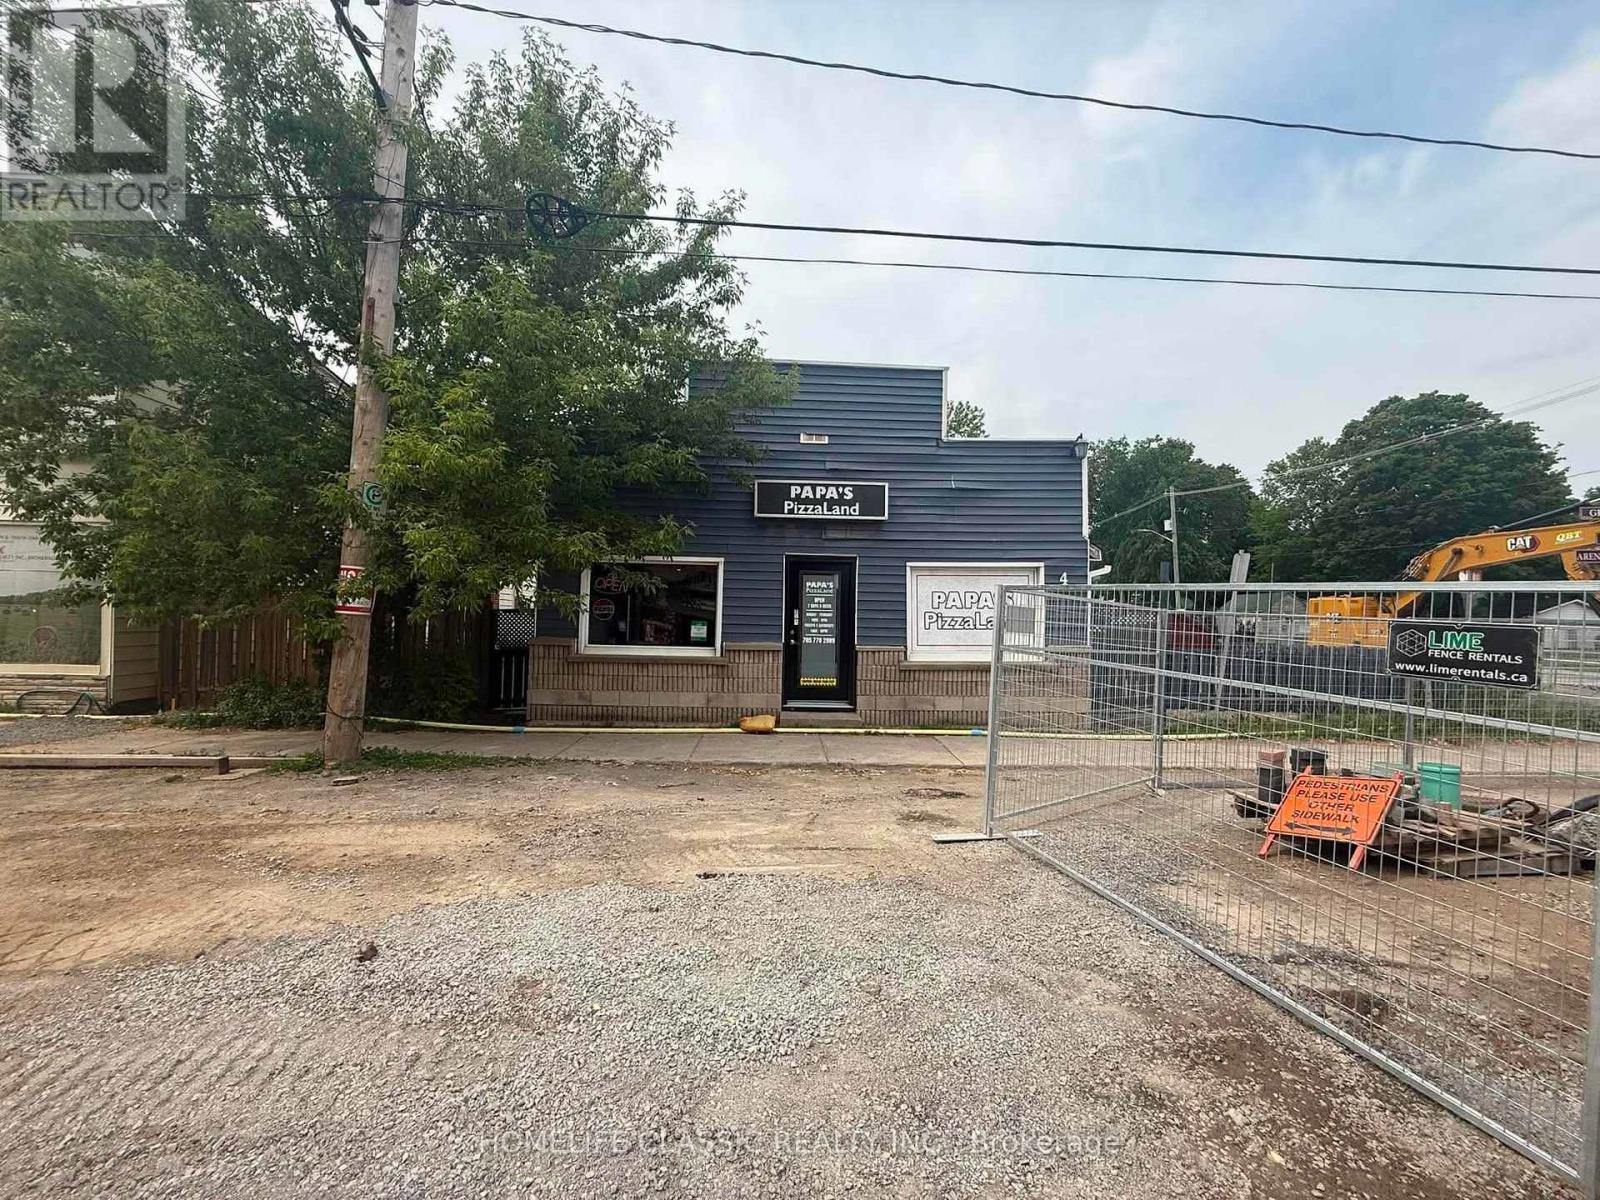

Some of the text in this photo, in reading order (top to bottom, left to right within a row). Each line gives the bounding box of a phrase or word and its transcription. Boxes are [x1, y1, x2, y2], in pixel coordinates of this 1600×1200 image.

[790, 485, 854, 500] PAPA'S
[784, 501, 860, 515] PizzaLand
[1506, 536, 1533, 552] CAT
[806, 581, 834, 589] PAPA'S
[1059, 572, 1069, 585] 4
[931, 590, 1015, 610] PAPAS
[924, 611, 995, 630] PizzaLa
[1428, 630, 1485, 652] LIME
[1427, 650, 1523, 665] FENCE RENTALS
[1395, 661, 1528, 683] www.limerentals.ca
[1296, 779, 1390, 794] PEDESTRIANS
[1296, 789, 1379, 803] PLEASE USE
[1308, 800, 1356, 812] OTHER
[1291, 809, 1360, 823] SIDEWALK
